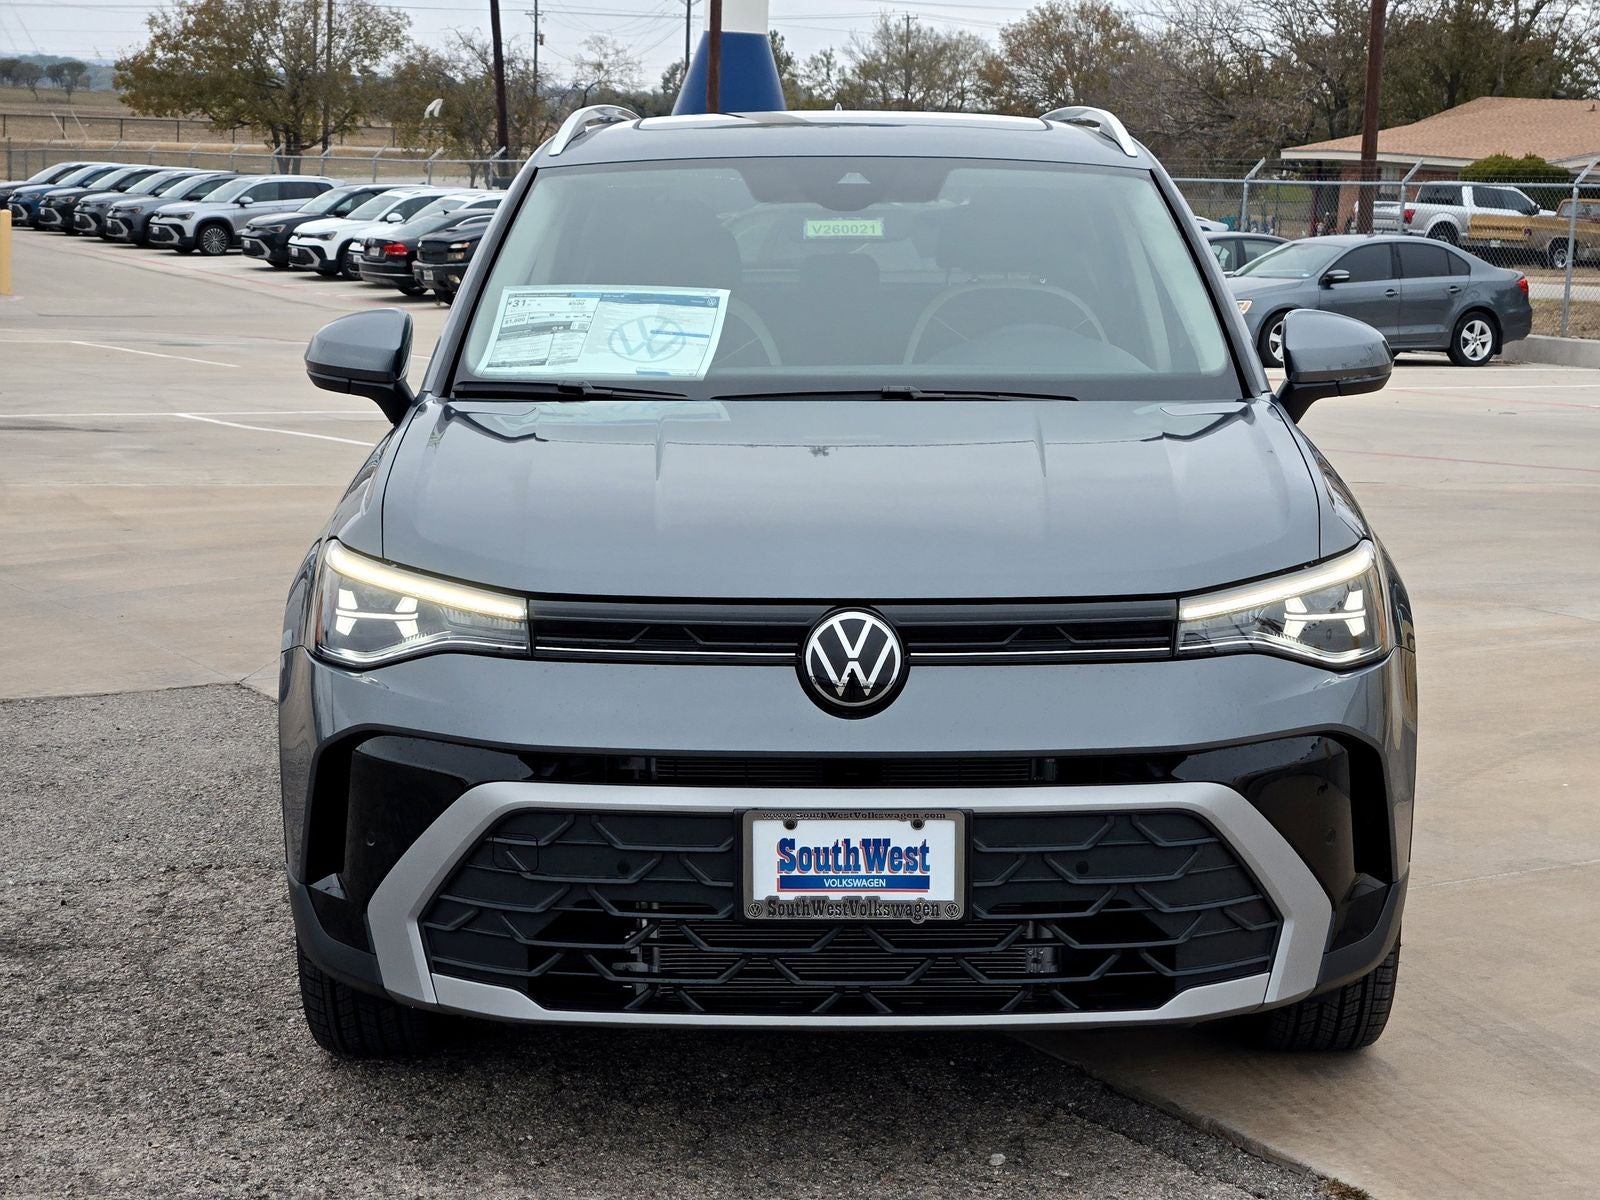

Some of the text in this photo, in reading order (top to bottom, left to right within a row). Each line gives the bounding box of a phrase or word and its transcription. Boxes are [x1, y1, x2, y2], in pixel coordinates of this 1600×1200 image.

[812, 223, 877, 234] V260021
[761, 811, 947, 820] www.SouthWestVolkswagen.com
[777, 838, 931, 875] SouthWest
[823, 878, 887, 888] VOLKSWAGEN
[766, 899, 941, 921] SouthWestVolkswagen
